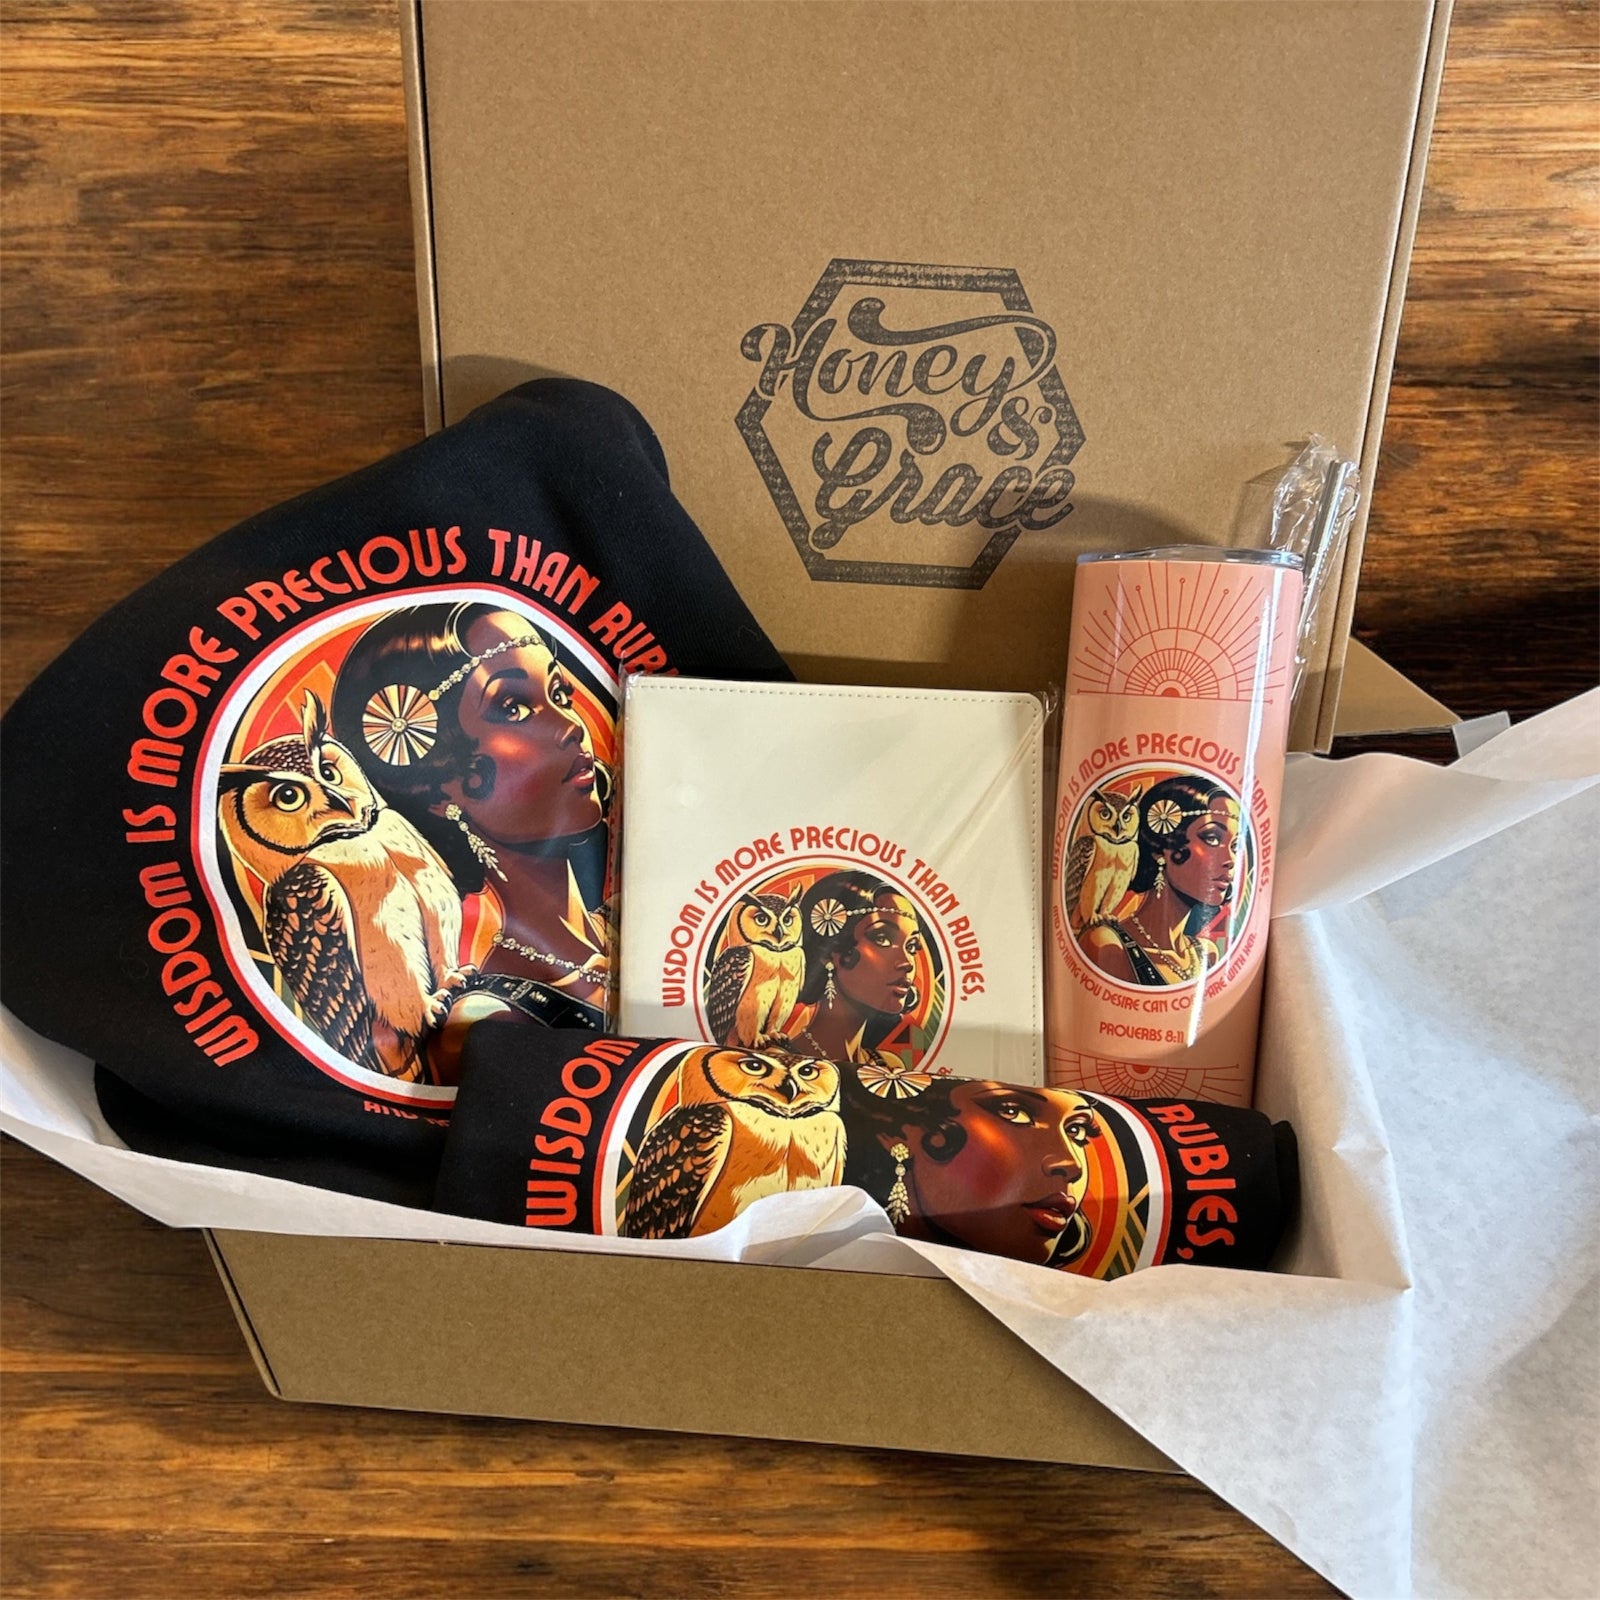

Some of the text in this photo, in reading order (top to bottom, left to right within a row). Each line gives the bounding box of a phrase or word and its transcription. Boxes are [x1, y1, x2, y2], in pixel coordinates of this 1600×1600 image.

[740, 297, 1057, 460] Honey &
[811, 427, 1075, 549] Grace
[122, 525, 679, 1067] WISDOM IS MORE PRECIOUS THAN RUB
[1052, 796, 1072, 880] WISDOM
[1068, 775, 1080, 798] IS
[1079, 736, 1130, 782] MORE
[1136, 732, 1241, 775] PRECIOUS
[662, 825, 986, 1007] WISDOM IS MORE PRECIOUS THAN RUBIES,
[1056, 929, 1082, 978] NOTHING
[1080, 973, 1102, 996] YOU
[1102, 989, 1140, 1011] DESIRE
[1142, 998, 1168, 1013] CAN
[1171, 977, 1228, 1011] COARE
[1226, 957, 1247, 982] WITH
[1099, 1021, 1185, 1043] PROVERBS 8:11
[526, 1039, 640, 1226] WISDOM
[1146, 1103, 1238, 1259] RUBIES,
